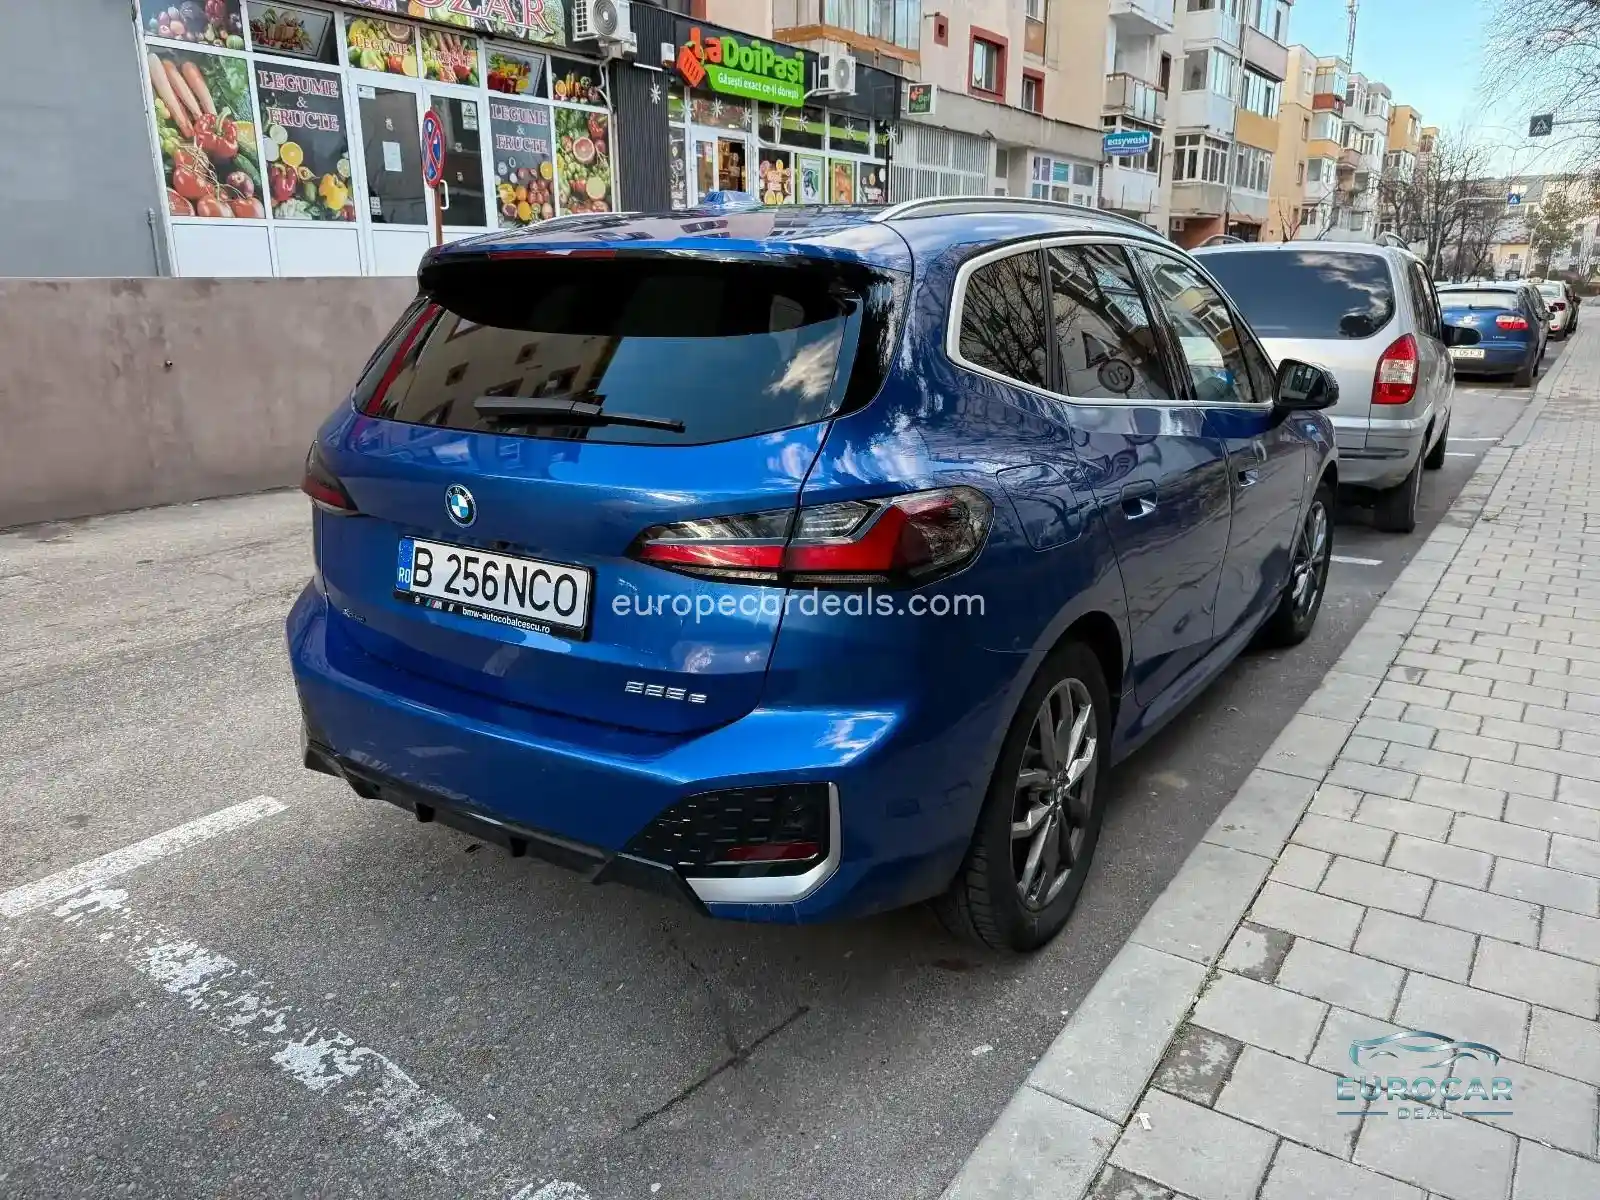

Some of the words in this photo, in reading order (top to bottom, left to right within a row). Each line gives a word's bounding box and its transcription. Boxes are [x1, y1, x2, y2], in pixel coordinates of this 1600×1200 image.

[258, 70, 339, 98] LEGUME
[296, 96, 309, 108] &
[266, 107, 340, 132] FRUCTE
[490, 104, 548, 126] LEGUME
[496, 134, 550, 155] FRUCTE
[1107, 134, 1148, 148] easywash
[398, 566, 411, 584] RO
[412, 547, 434, 588] B
[462, 606, 551, 634] bmw-autocobalcescu.ro
